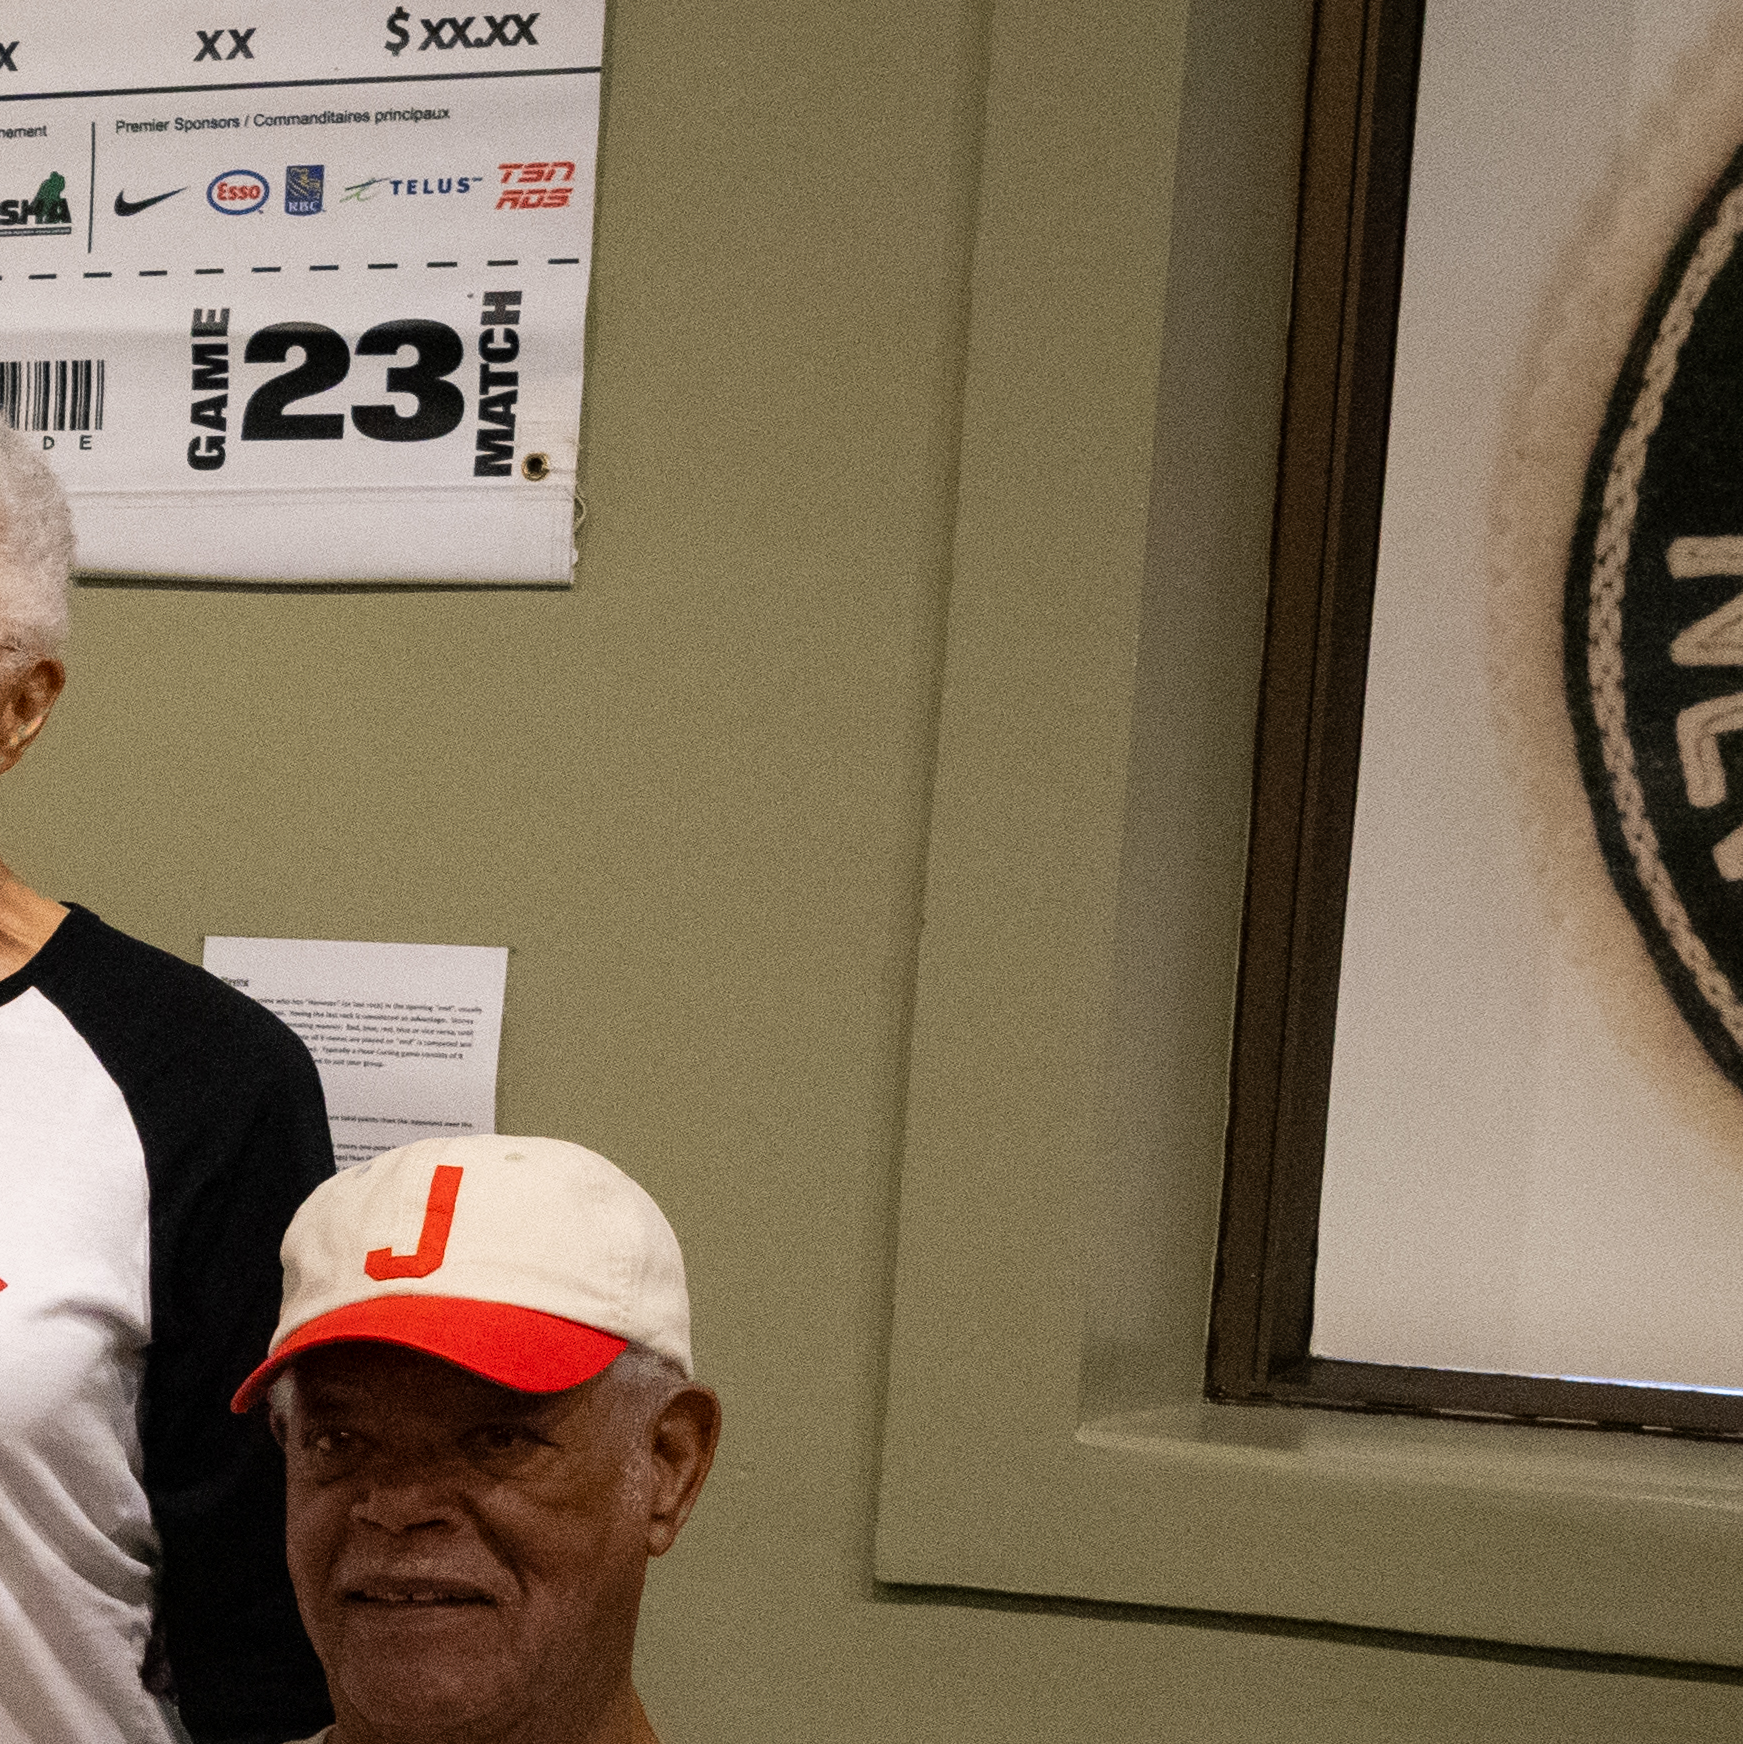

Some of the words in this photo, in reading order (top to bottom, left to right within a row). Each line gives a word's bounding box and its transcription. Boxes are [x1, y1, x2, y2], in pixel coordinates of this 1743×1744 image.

[116, 117, 169, 134] Premier
[174, 114, 240, 133] Sponsors
[253, 109, 370, 128] Commanditaires
[374, 107, 451, 125] principaux
[390, 176, 472, 196] TELUS
[187, 308, 230, 471] GAME
[241, 318, 464, 442] 23
[473, 290, 523, 477] MATCH
[364, 1165, 464, 1281] J
